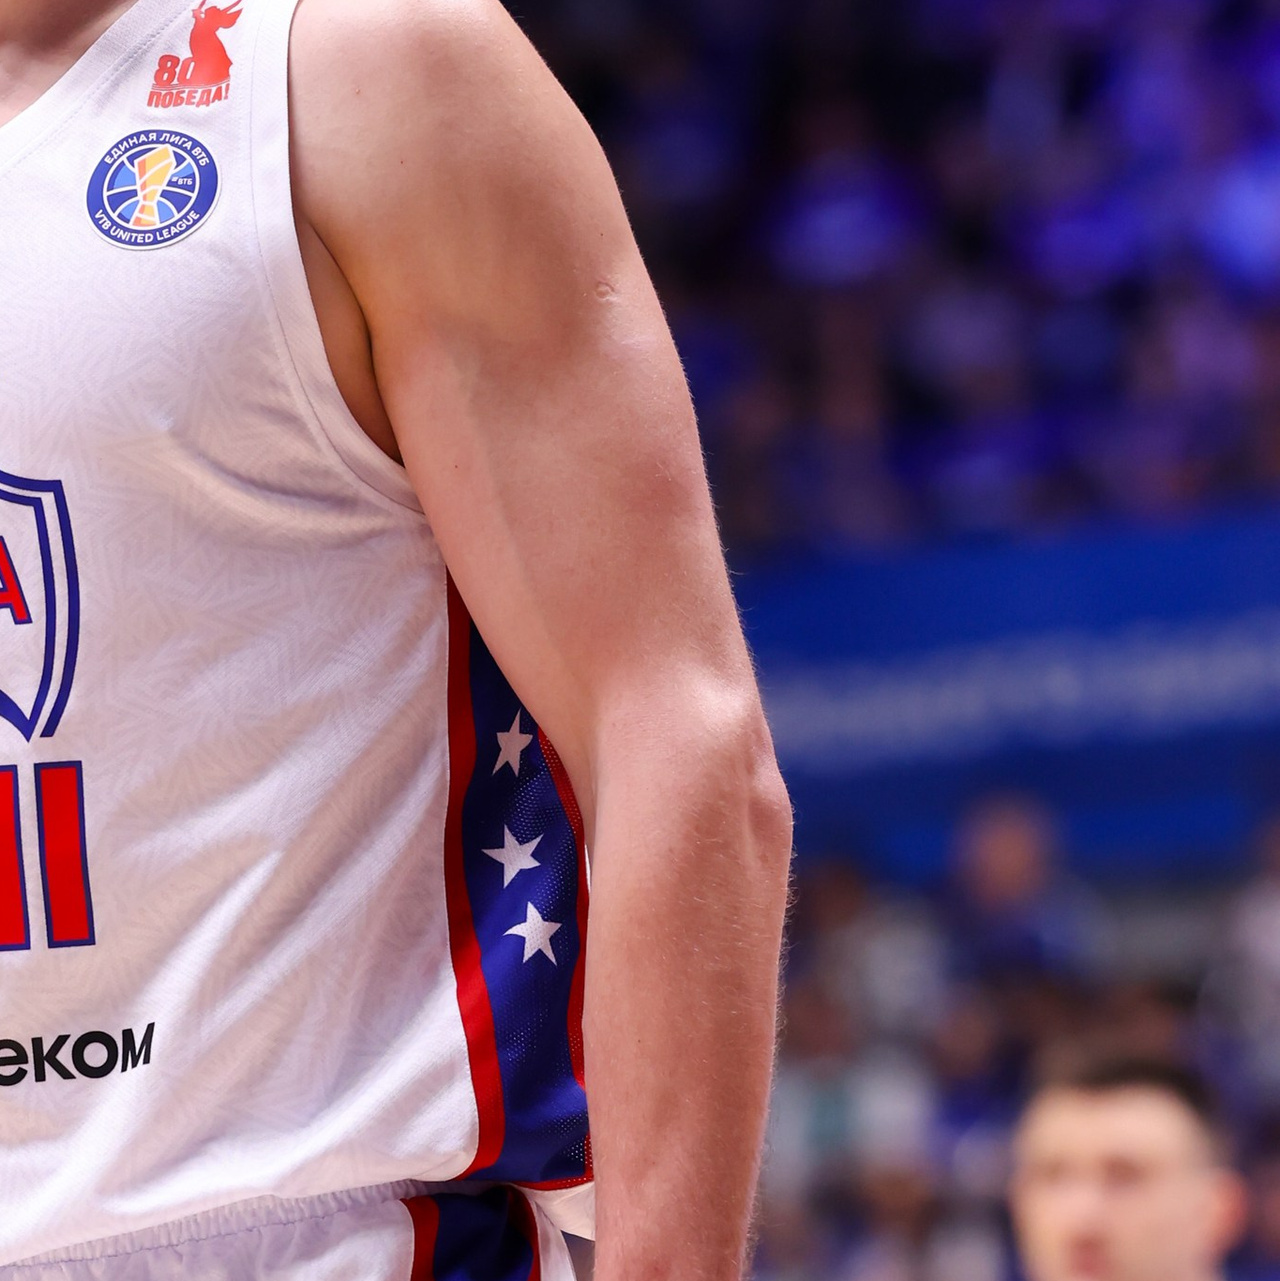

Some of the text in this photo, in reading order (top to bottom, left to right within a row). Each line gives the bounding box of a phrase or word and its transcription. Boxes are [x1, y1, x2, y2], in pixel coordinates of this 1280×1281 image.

[154, 54, 198, 86] 80
[147, 83, 230, 108] ПОБЕДА!
[104, 133, 210, 167] ЕДИНАЯ ЛИГА ВТБ
[178, 177, 193, 186] ВТБ
[94, 209, 200, 243] VTB UNITED LEAGUE
